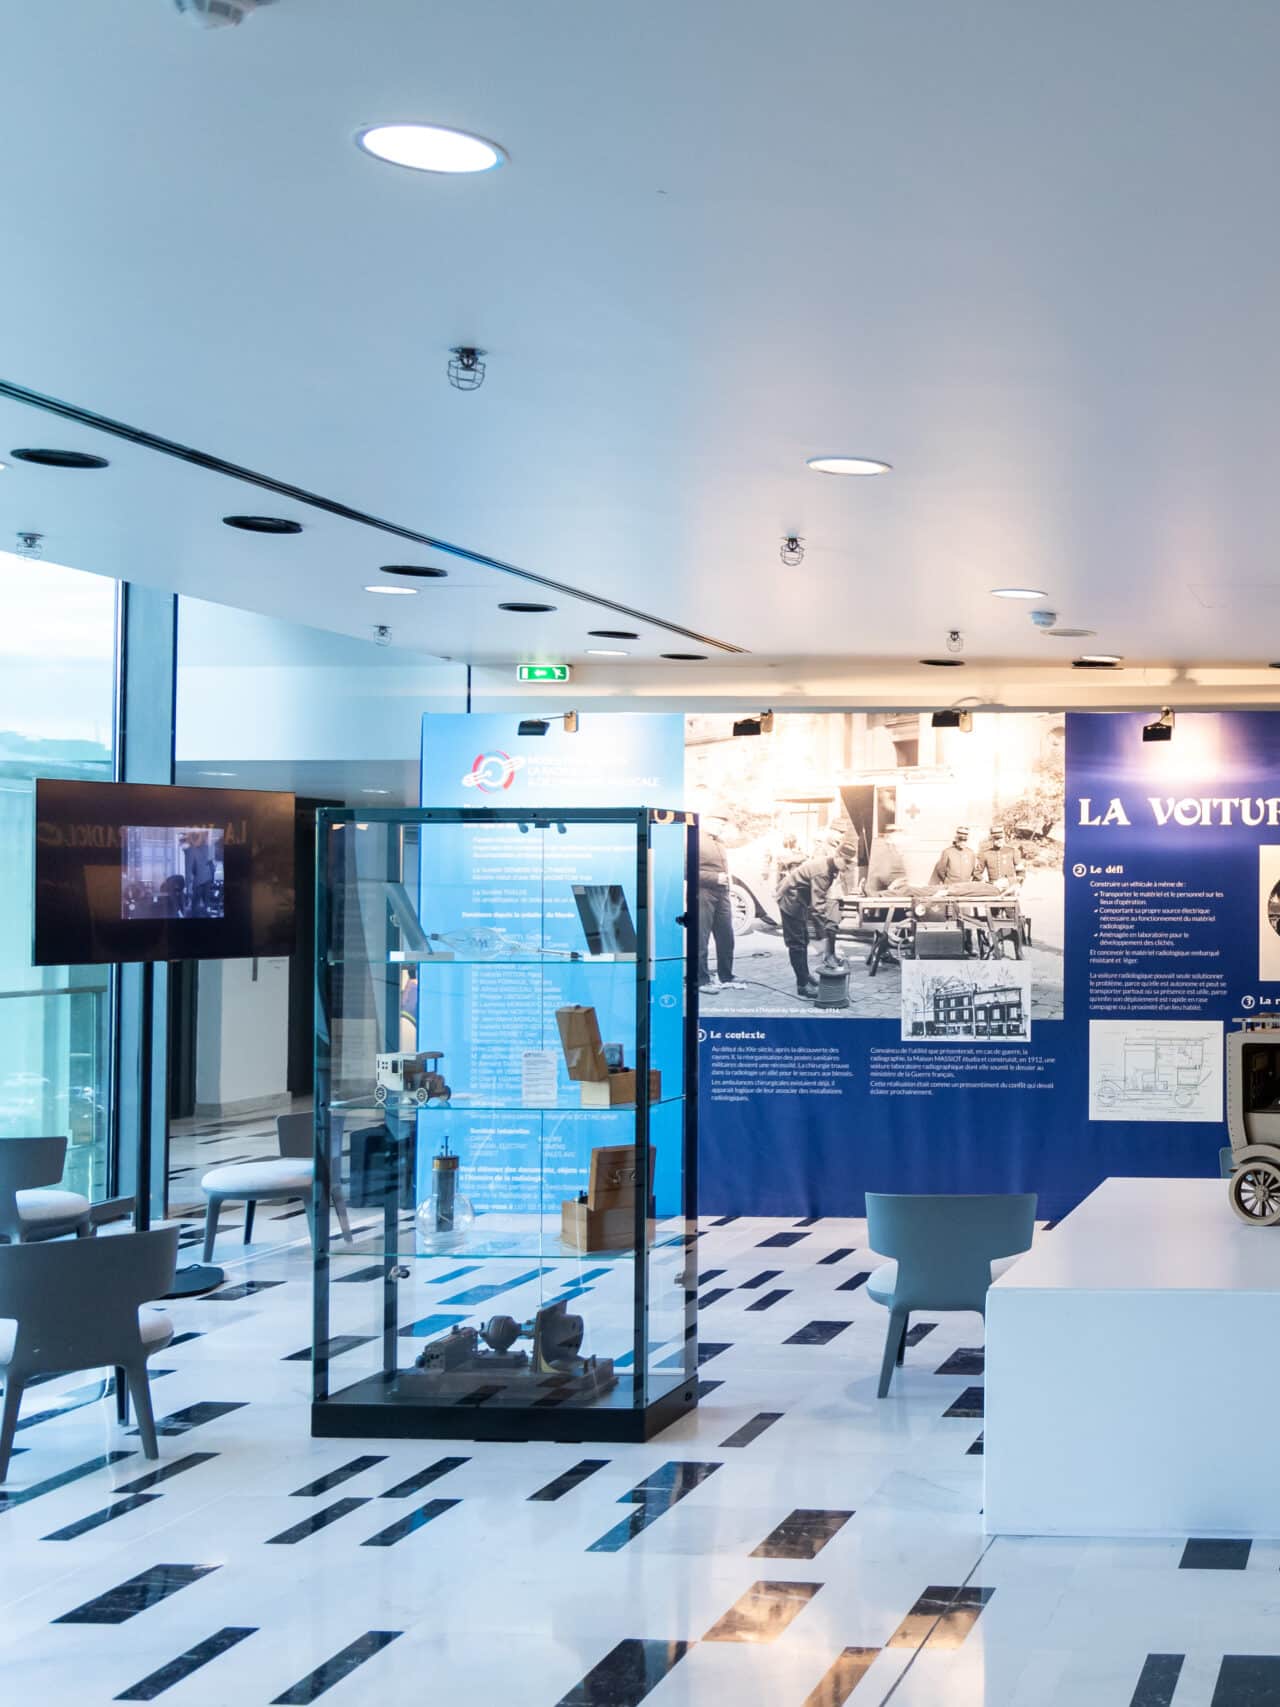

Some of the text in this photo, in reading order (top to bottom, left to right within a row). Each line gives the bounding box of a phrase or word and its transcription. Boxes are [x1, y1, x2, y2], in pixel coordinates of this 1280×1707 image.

[1078, 798, 1131, 827] LA
[1089, 865, 1102, 874] Le
[1105, 864, 1124, 874] défi
[1259, 996, 1271, 1005] La
[710, 1031, 721, 1039] Le
[725, 1030, 766, 1040] contexte
